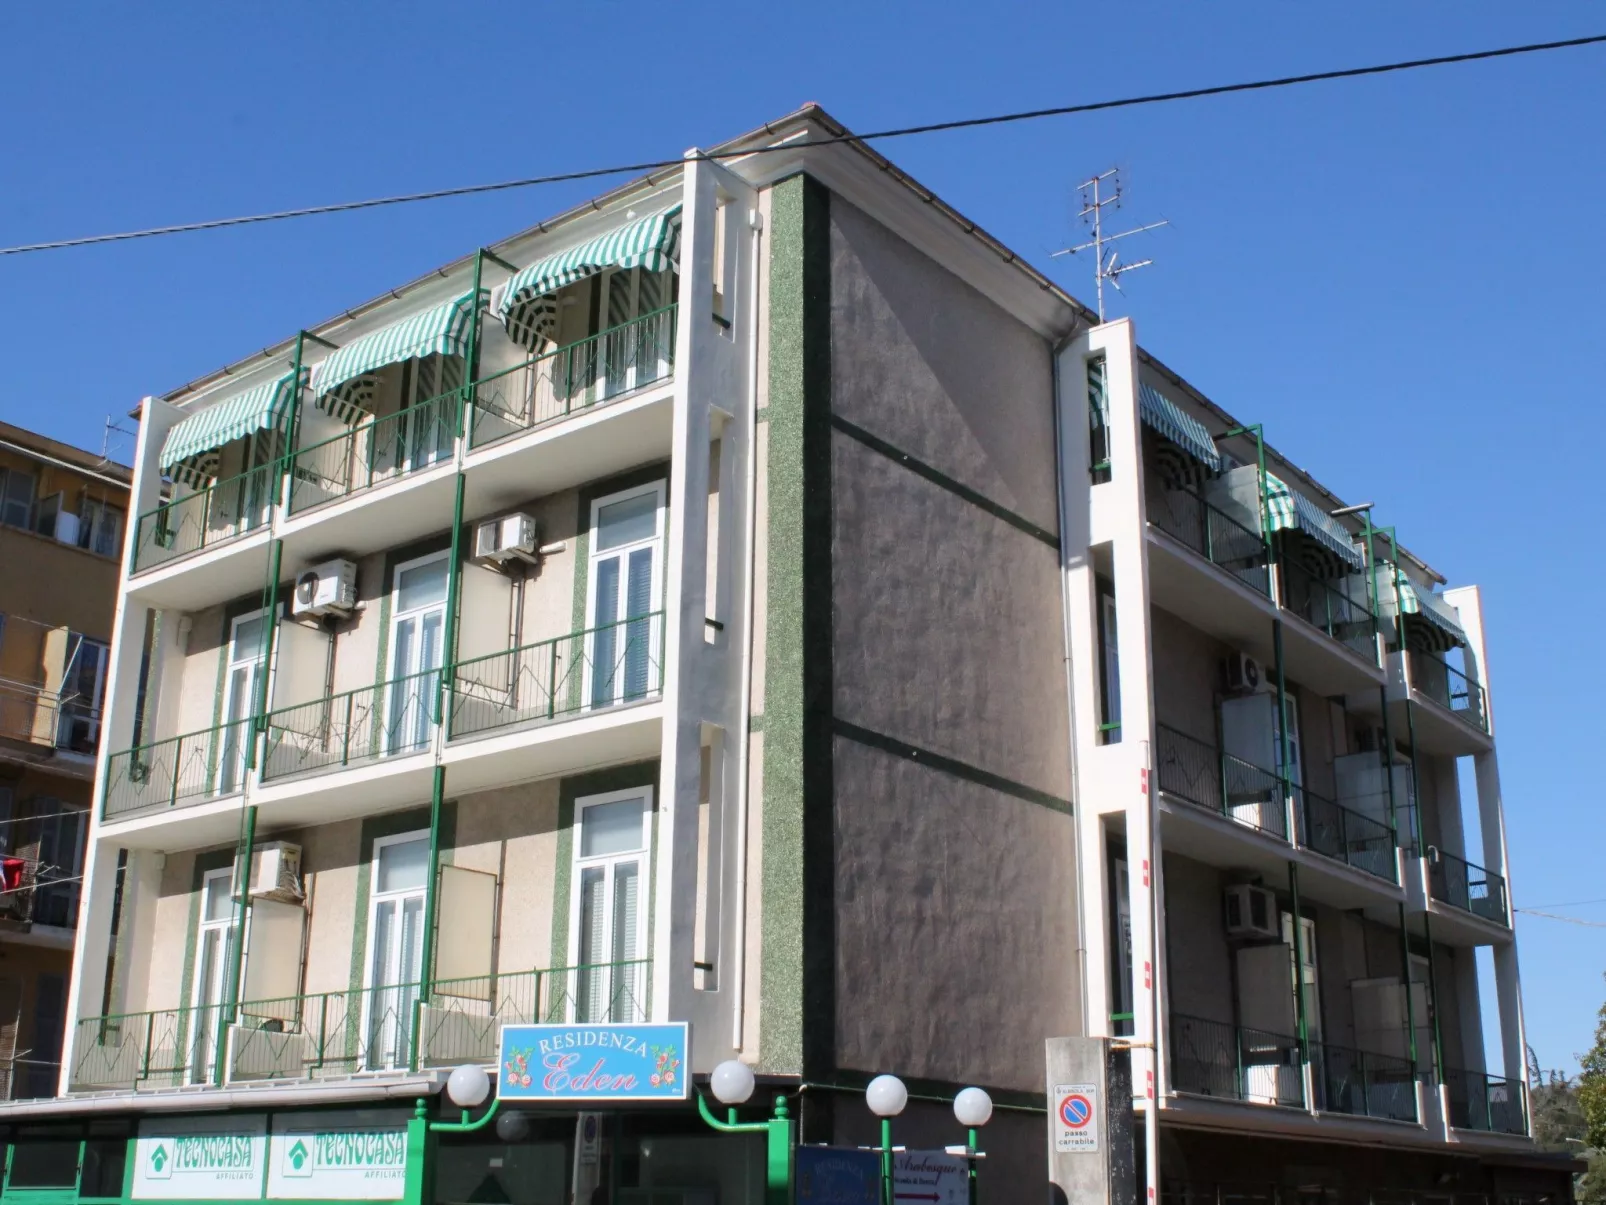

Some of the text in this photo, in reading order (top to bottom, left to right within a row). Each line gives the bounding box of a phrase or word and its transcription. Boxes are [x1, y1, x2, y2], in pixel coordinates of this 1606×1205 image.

[539, 1031, 647, 1058] RESIDENZA
[542, 1052, 640, 1094] Eden
[1064, 1130, 1088, 1138] passo
[176, 1134, 252, 1168] TECNOCASA
[316, 1130, 404, 1166] TECNOCASA
[216, 1172, 254, 1180] AFFILIATO
[364, 1170, 406, 1179] AFFILIATO
